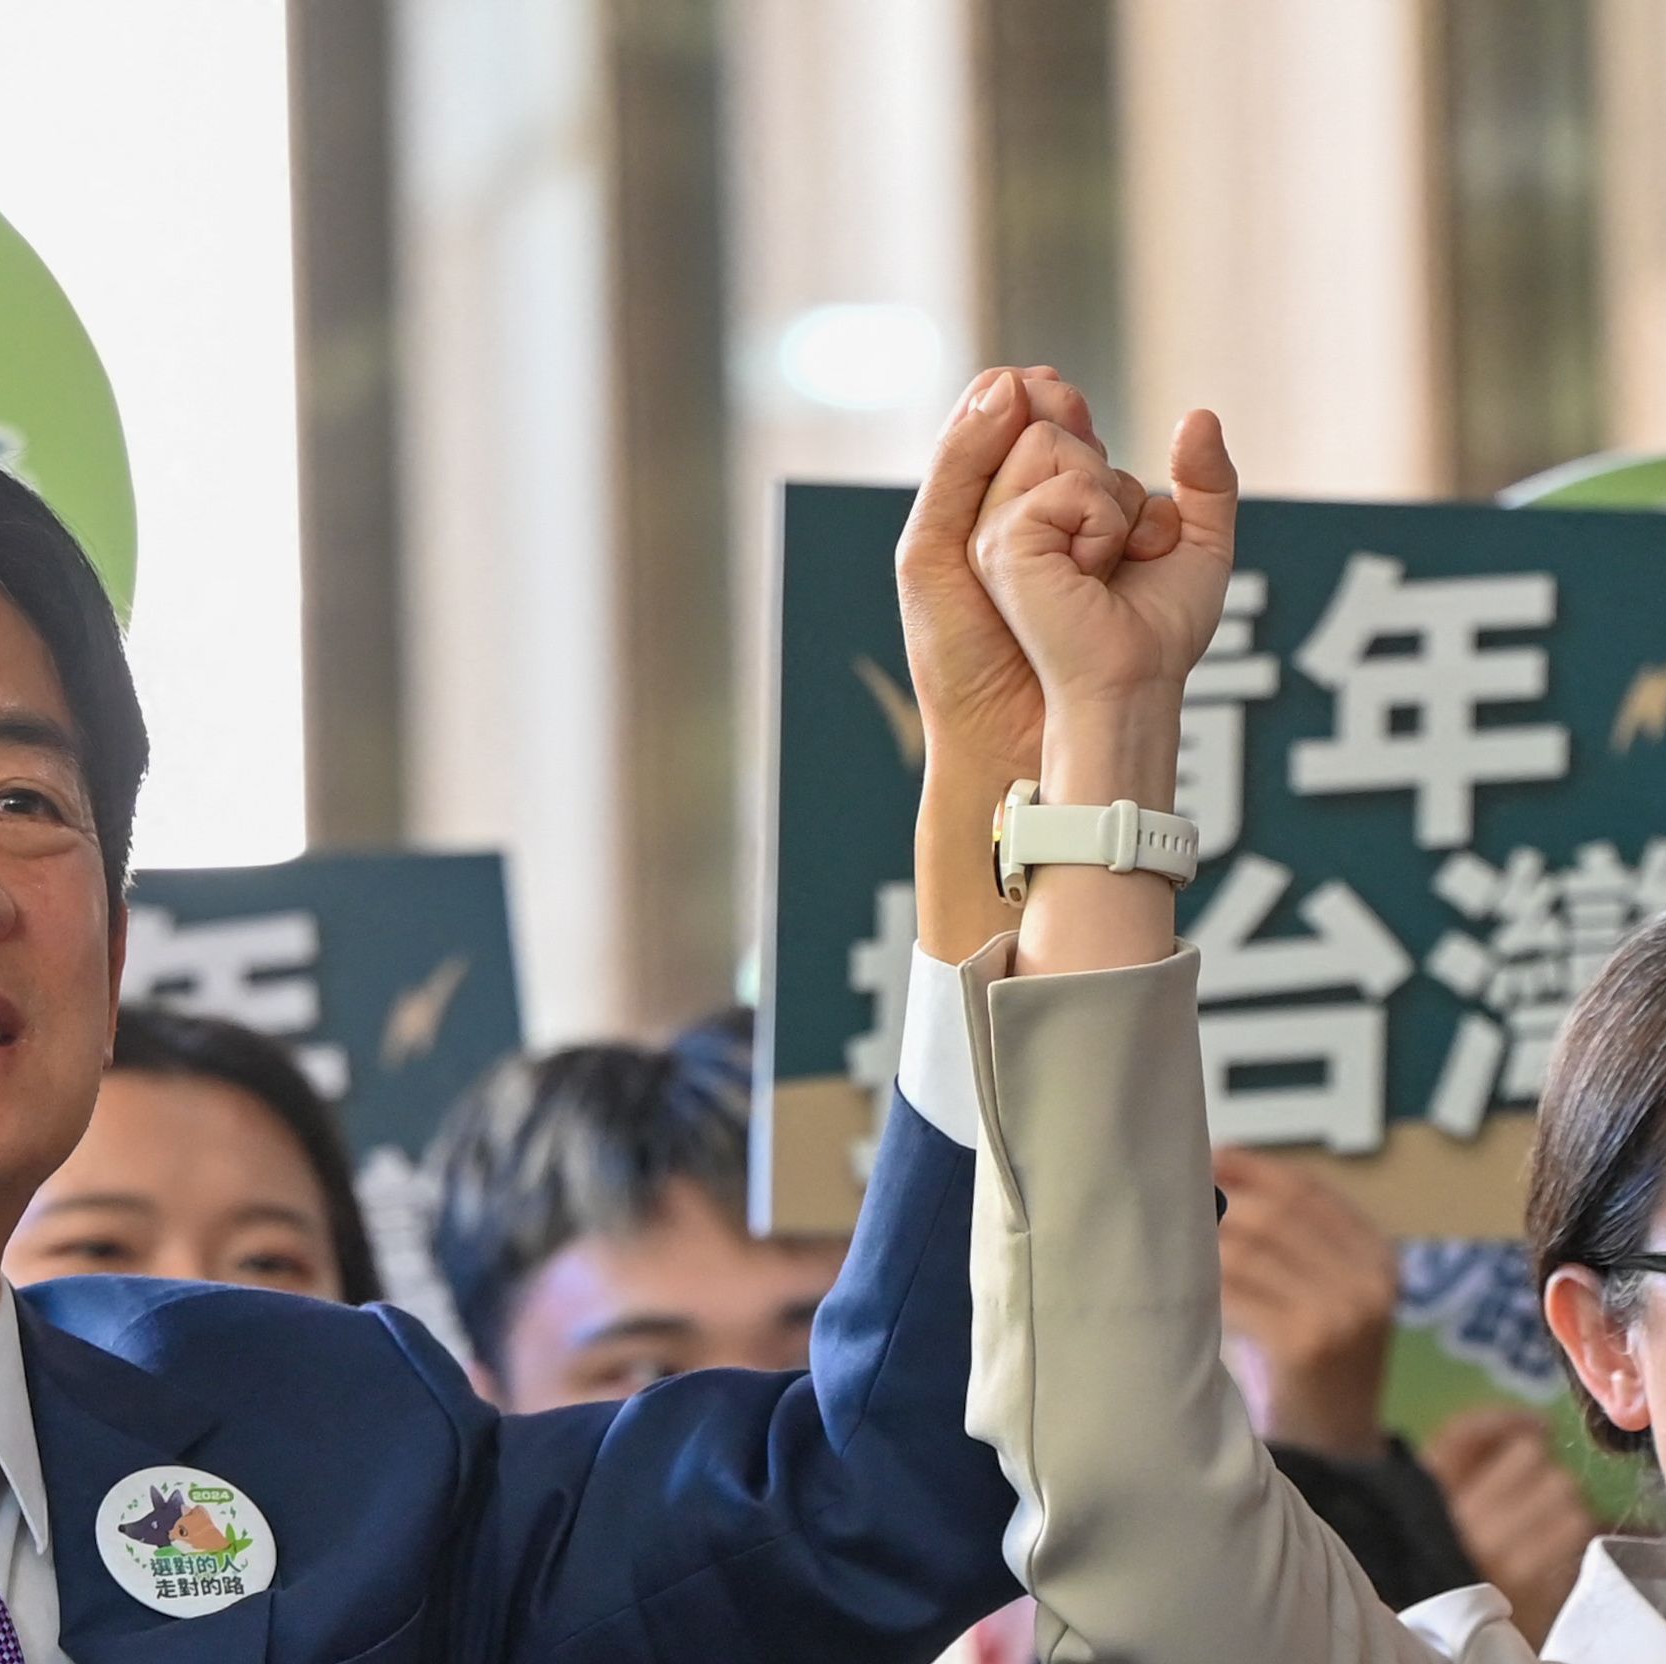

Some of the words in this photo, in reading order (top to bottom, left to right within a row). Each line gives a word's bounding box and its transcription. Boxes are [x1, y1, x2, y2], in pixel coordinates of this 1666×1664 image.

[191, 1490, 231, 1502] 2024
[150, 1554, 241, 1578] 選對的人
[155, 1576, 245, 1600] 走對的路
